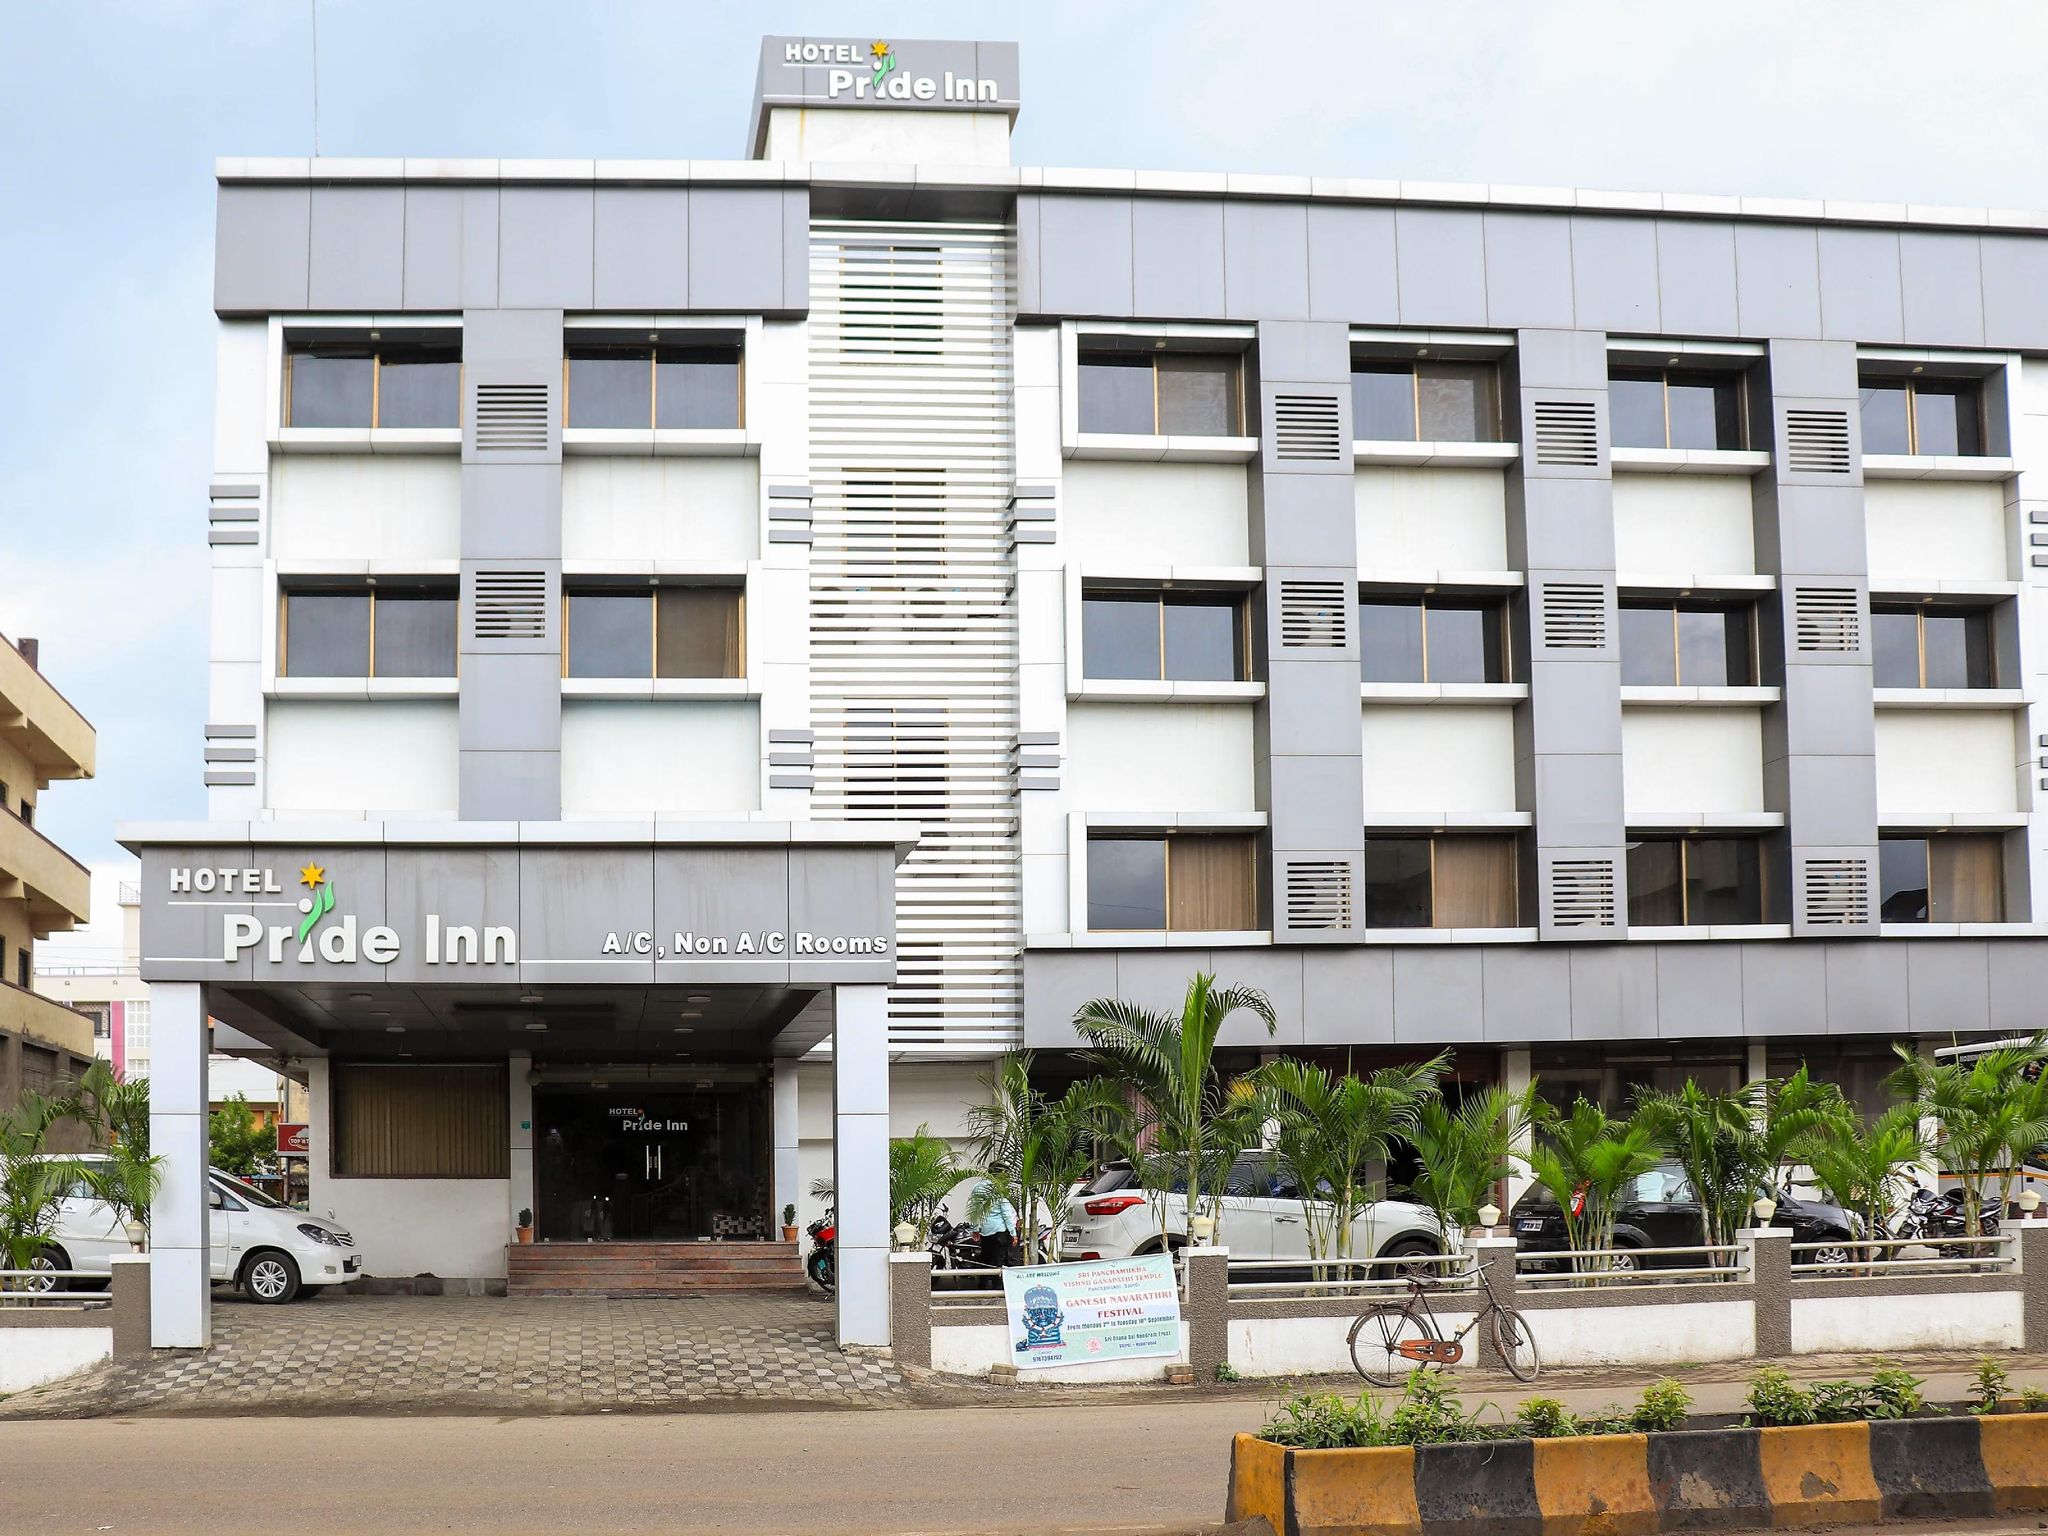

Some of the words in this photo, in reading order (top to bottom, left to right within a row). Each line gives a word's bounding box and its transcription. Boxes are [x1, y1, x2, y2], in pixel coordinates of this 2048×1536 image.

[785, 43, 863, 62] HOTEL
[828, 66, 937, 100] Pride
[944, 71, 998, 102] Inn
[169, 868, 282, 892] HOTEL
[222, 912, 400, 965] Pride
[426, 914, 516, 965] Inn
[675, 931, 727, 954] Non
[735, 931, 785, 955] A/C
[796, 931, 888, 955] Rooms
[622, 1118, 662, 1131] Pride
[666, 1119, 688, 1131] Inn
[1063, 1279, 1091, 1288] VISHNU
[1093, 1276, 1134, 1286] GANAPATHI
[1135, 1272, 1164, 1283] TEMPLE
[1078, 1271, 1091, 1279] SRI
[1092, 1266, 1147, 1278] PANCHAMUKHA
[1066, 1296, 1107, 1308] GANESH
[1109, 1291, 1173, 1304] NAVARATHRI
[1097, 1307, 1144, 1318] FESTIVAL
[1067, 1323, 1081, 1331] From
[1081, 1321, 1102, 1330] Monday
[1117, 1319, 1138, 1327] Tuesday
[1147, 1315, 1176, 1325] September
